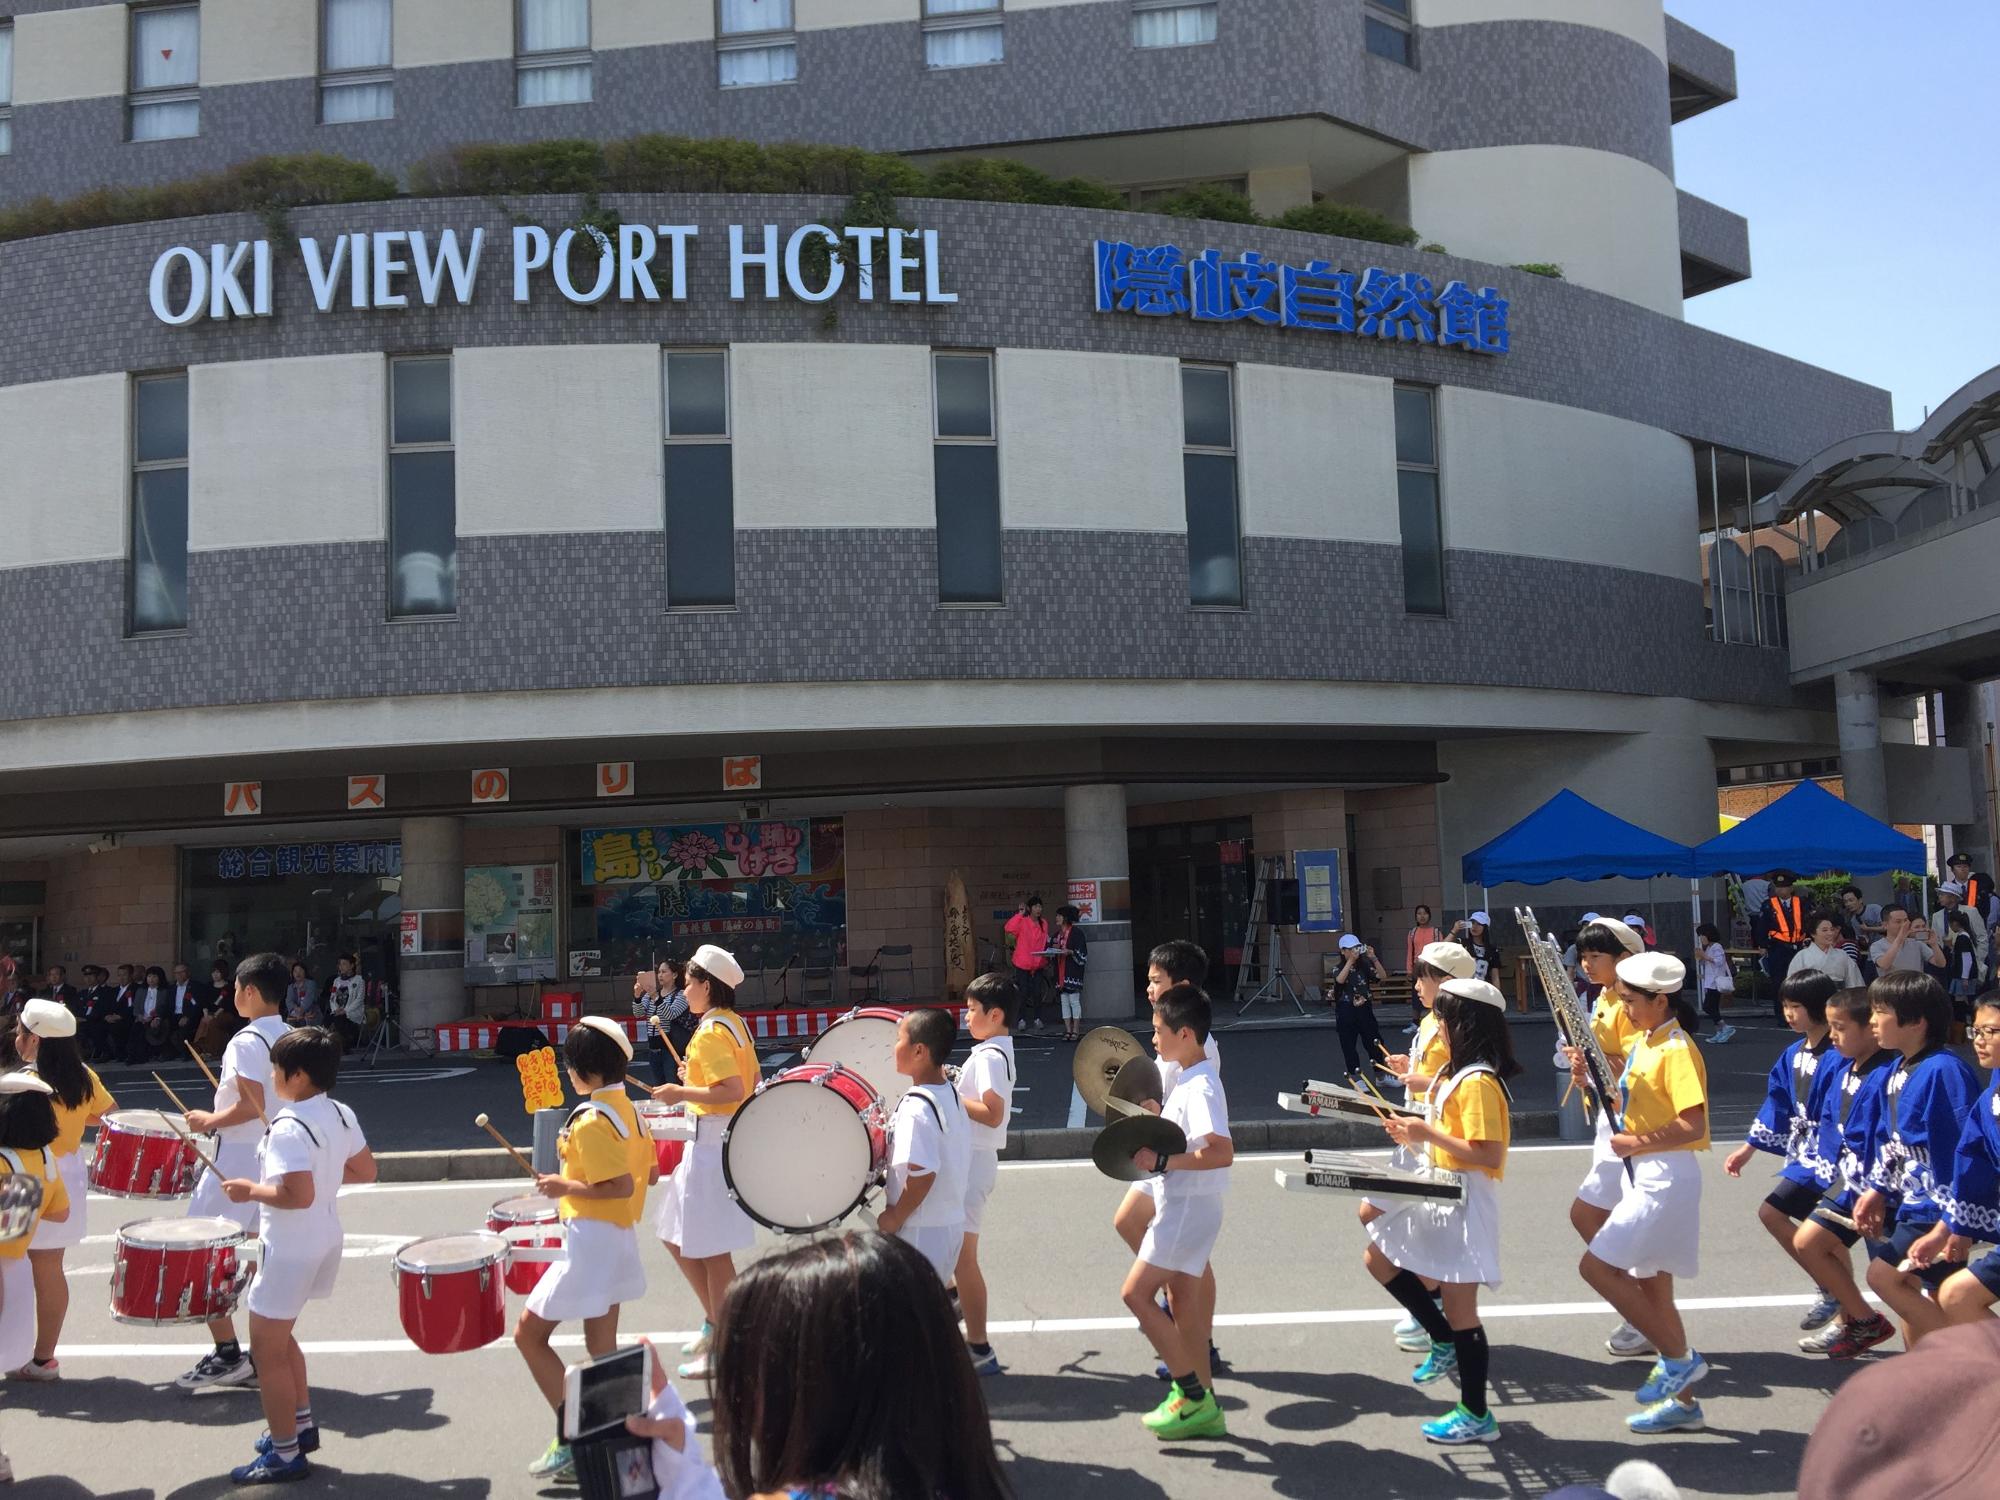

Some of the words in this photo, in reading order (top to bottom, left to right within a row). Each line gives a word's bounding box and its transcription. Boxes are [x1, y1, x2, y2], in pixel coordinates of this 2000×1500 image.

[149, 240, 273, 326] OKI
[299, 226, 485, 312] VIEW
[511, 224, 698, 305] PORT
[730, 223, 959, 305] HOTEL
[1093, 239, 1511, 355] 隠岐自然館
[225, 756, 760, 814] バスのりば
[592, 831, 641, 883] 島
[637, 828, 664, 881] まつり
[1308, 1095, 1339, 1109] YAMAHA
[1312, 1174, 1350, 1188] YAMAHA
